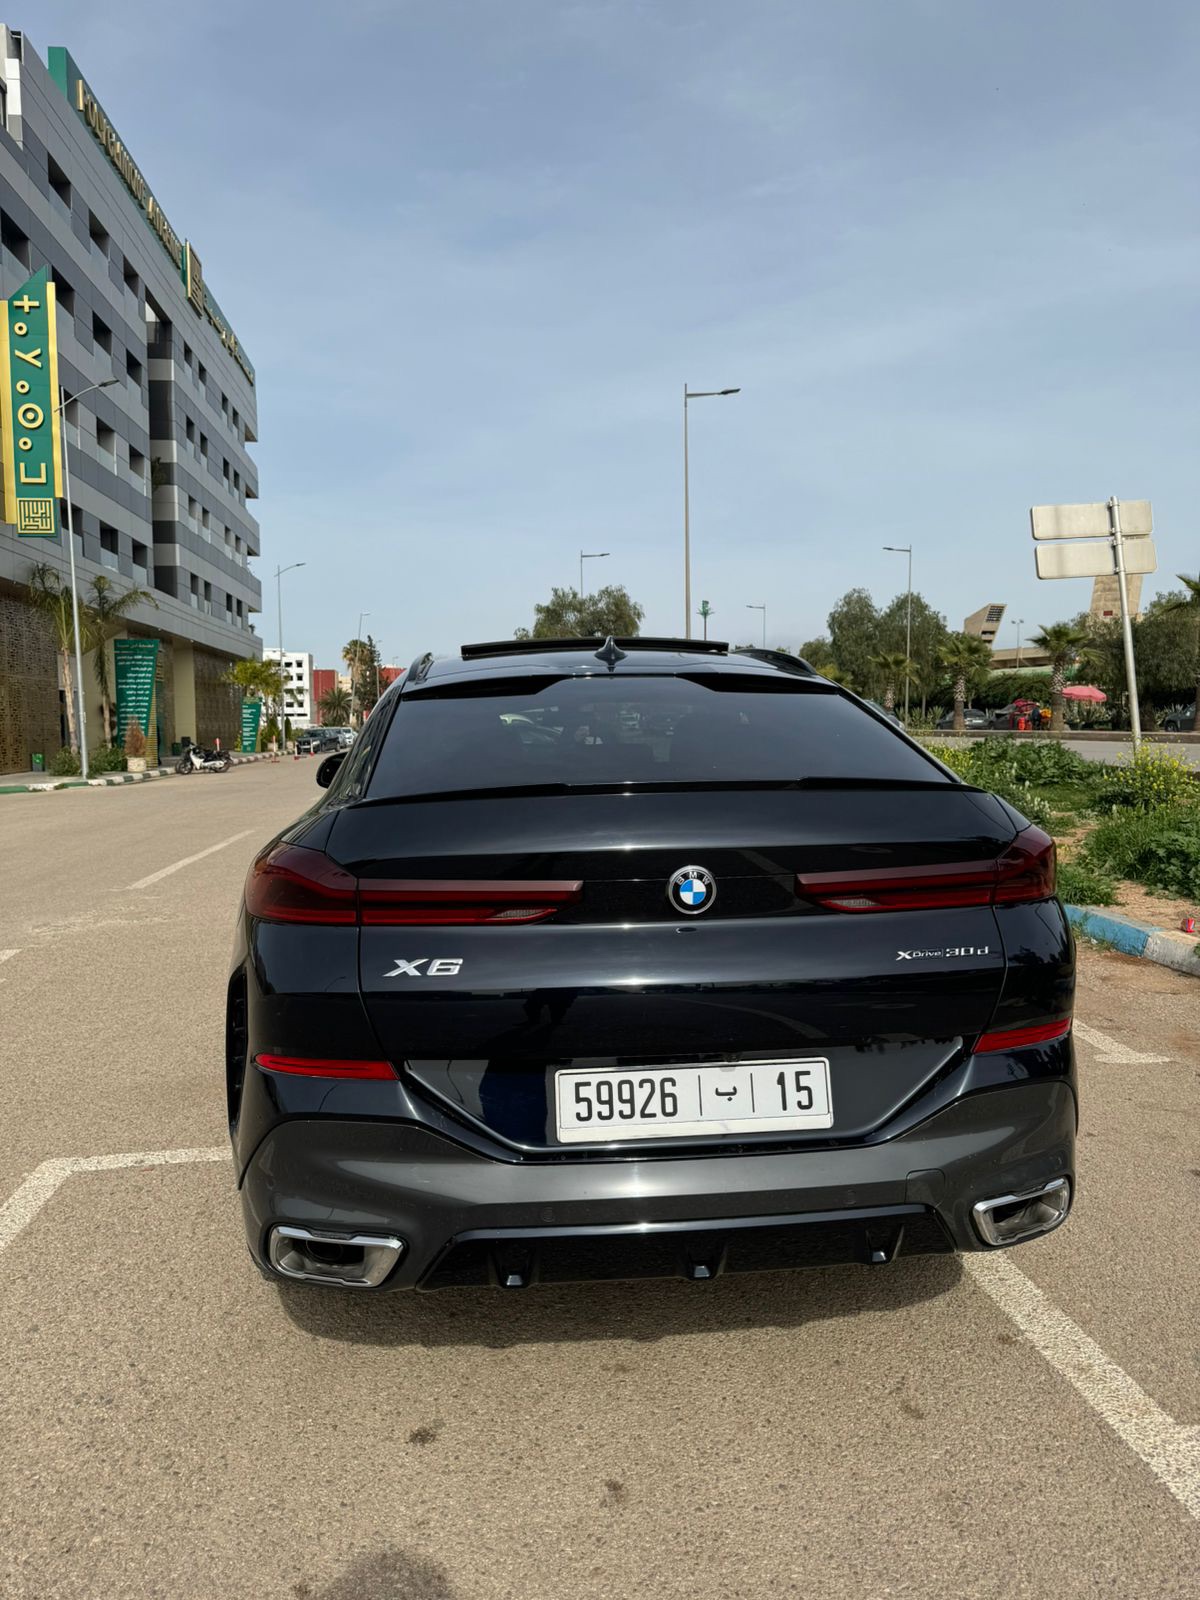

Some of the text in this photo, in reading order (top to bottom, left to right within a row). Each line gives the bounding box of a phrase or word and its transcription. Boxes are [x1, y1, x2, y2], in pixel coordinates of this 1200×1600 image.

[945, 945, 990, 958] 30d
[382, 957, 464, 978] X6
[574, 1070, 814, 1123] 59926 ب 15
